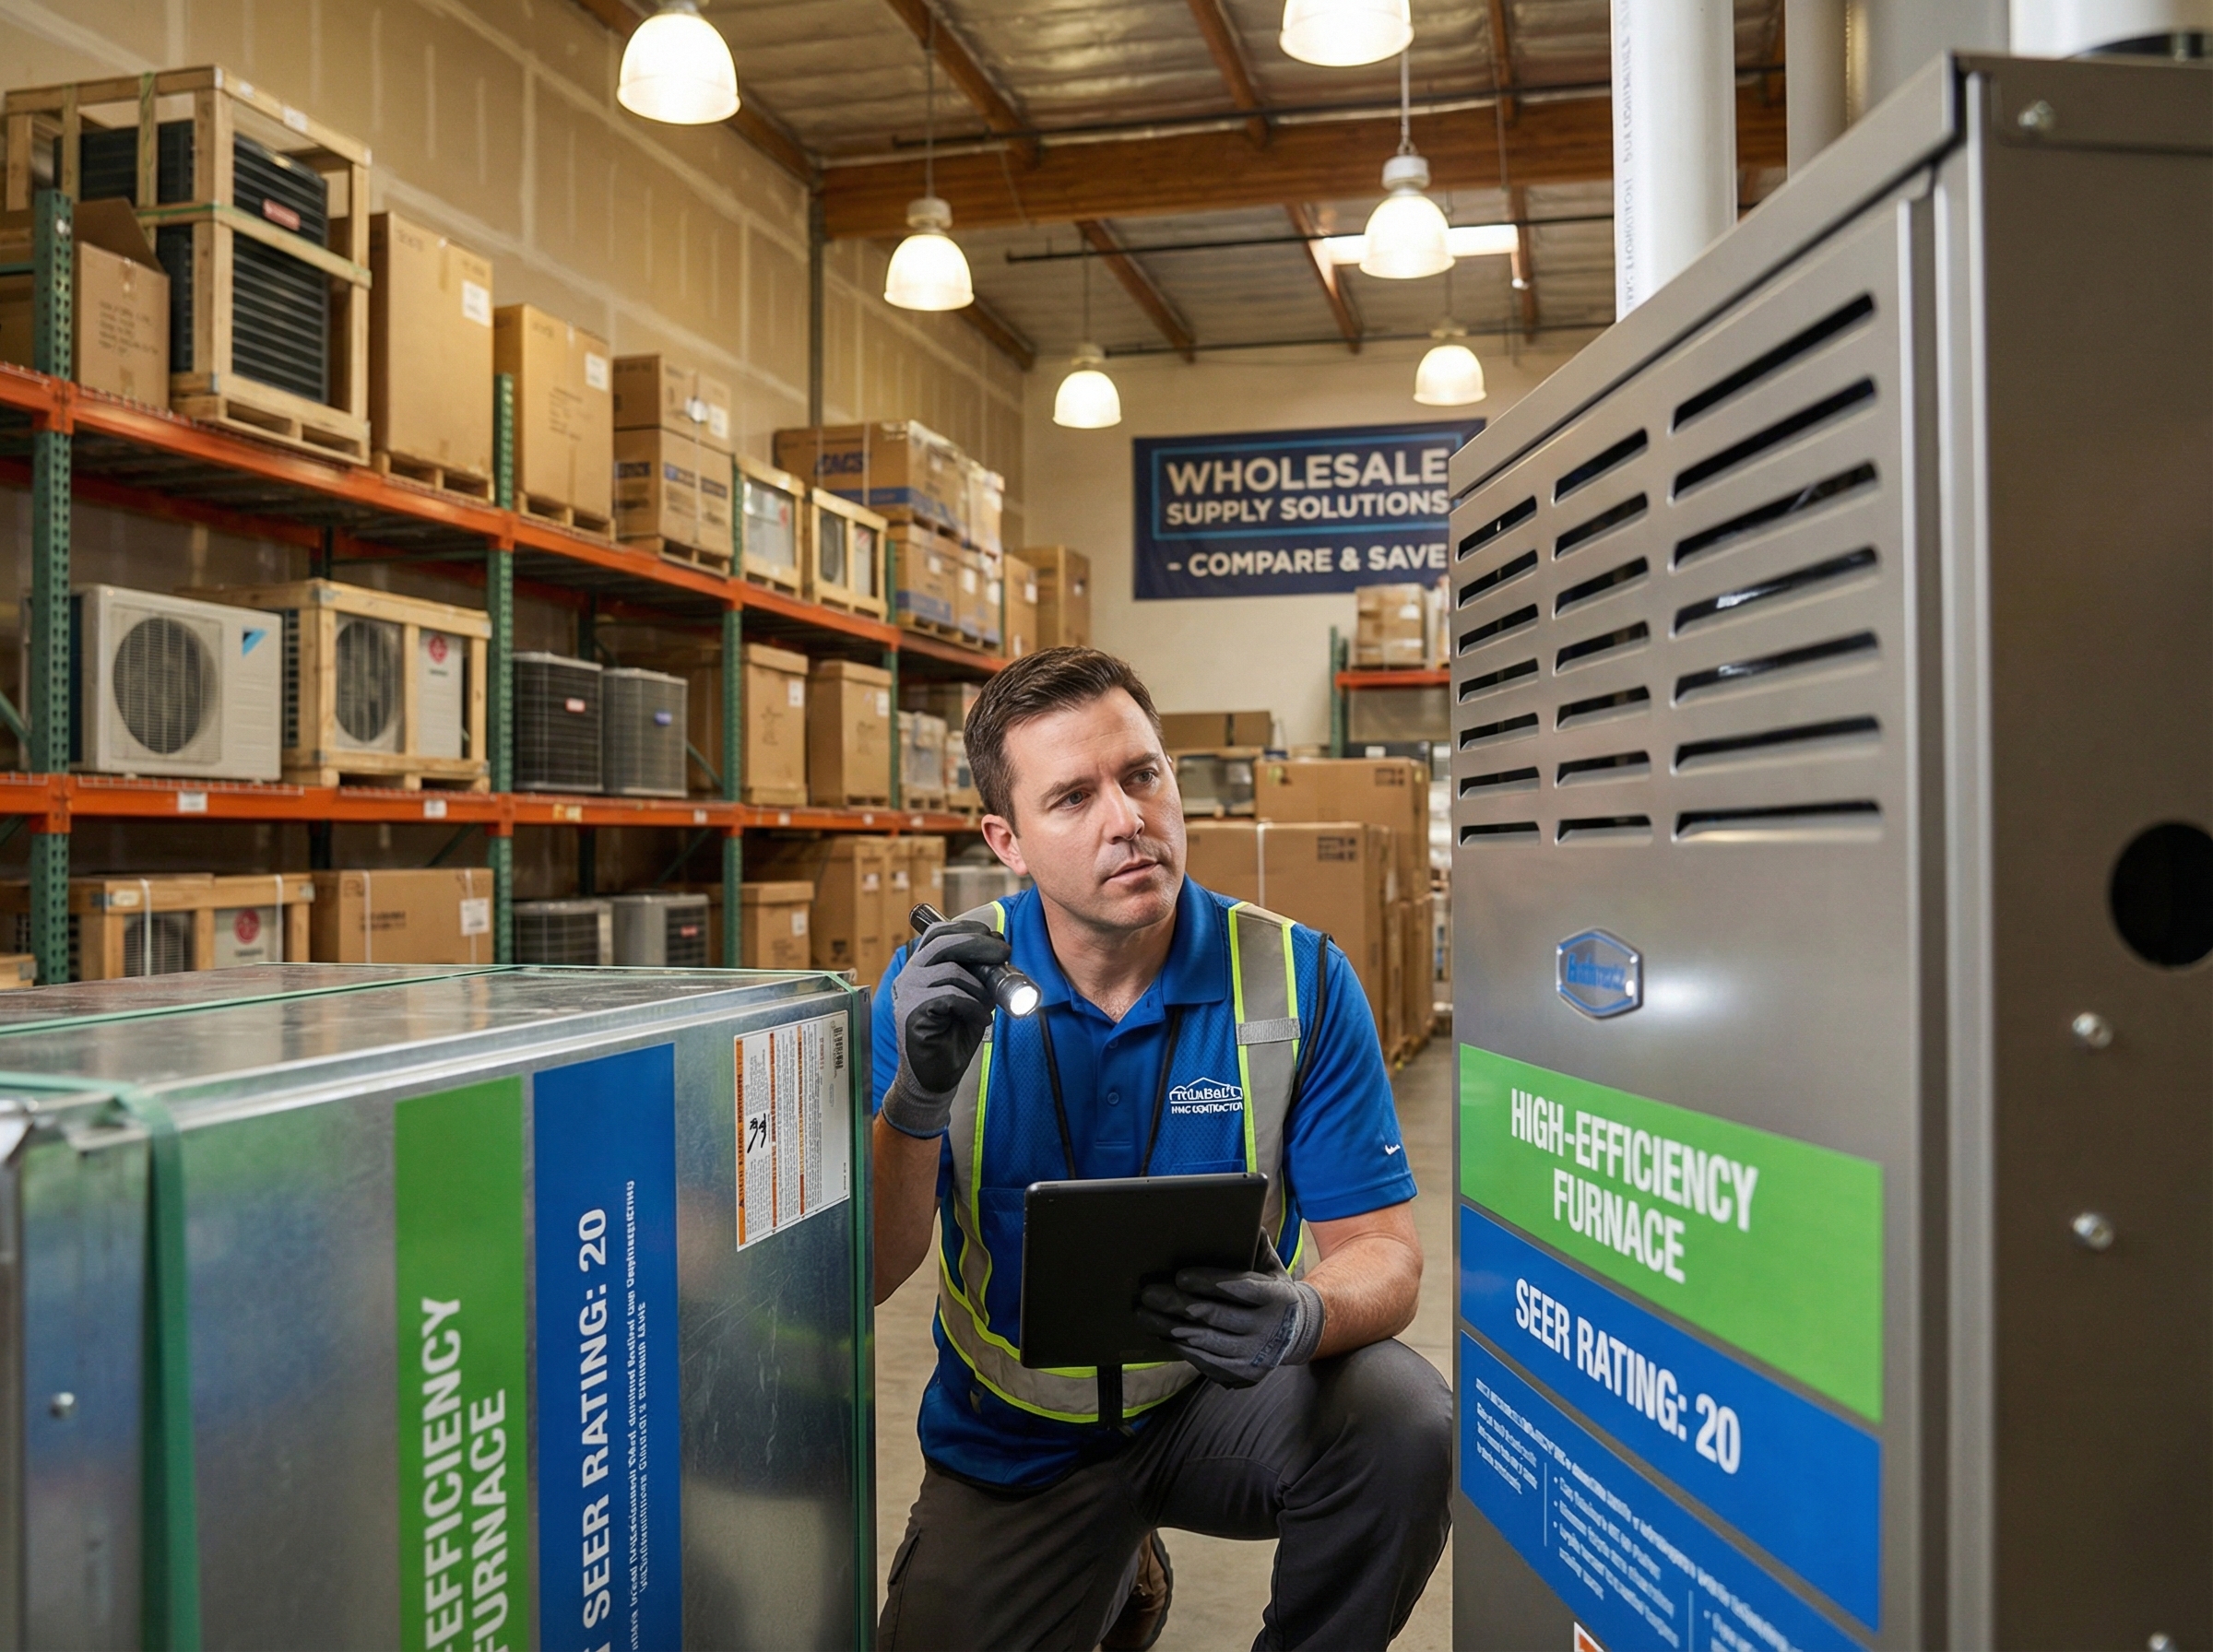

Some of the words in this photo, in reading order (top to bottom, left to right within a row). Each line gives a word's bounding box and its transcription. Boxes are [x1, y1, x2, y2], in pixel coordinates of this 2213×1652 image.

[1166, 498, 1273, 525] SUPPLY
[1281, 490, 1450, 520] SOLUTIONS
[1167, 450, 1449, 495] WHOLESALE
[1189, 548, 1333, 577] COMPARE
[1339, 547, 1361, 572] &
[1367, 543, 1448, 572] SAVE
[1510, 1087, 1759, 1233] HIGH-EFFICIENCY
[578, 1209, 608, 1273] 20
[1554, 1167, 1686, 1284] FURNACE
[579, 1284, 608, 1489] RATING:
[1515, 1278, 1570, 1361] SEER
[1577, 1316, 1687, 1441] RATING:
[1695, 1393, 1741, 1475] 20
[583, 1493, 610, 1628] SEER
